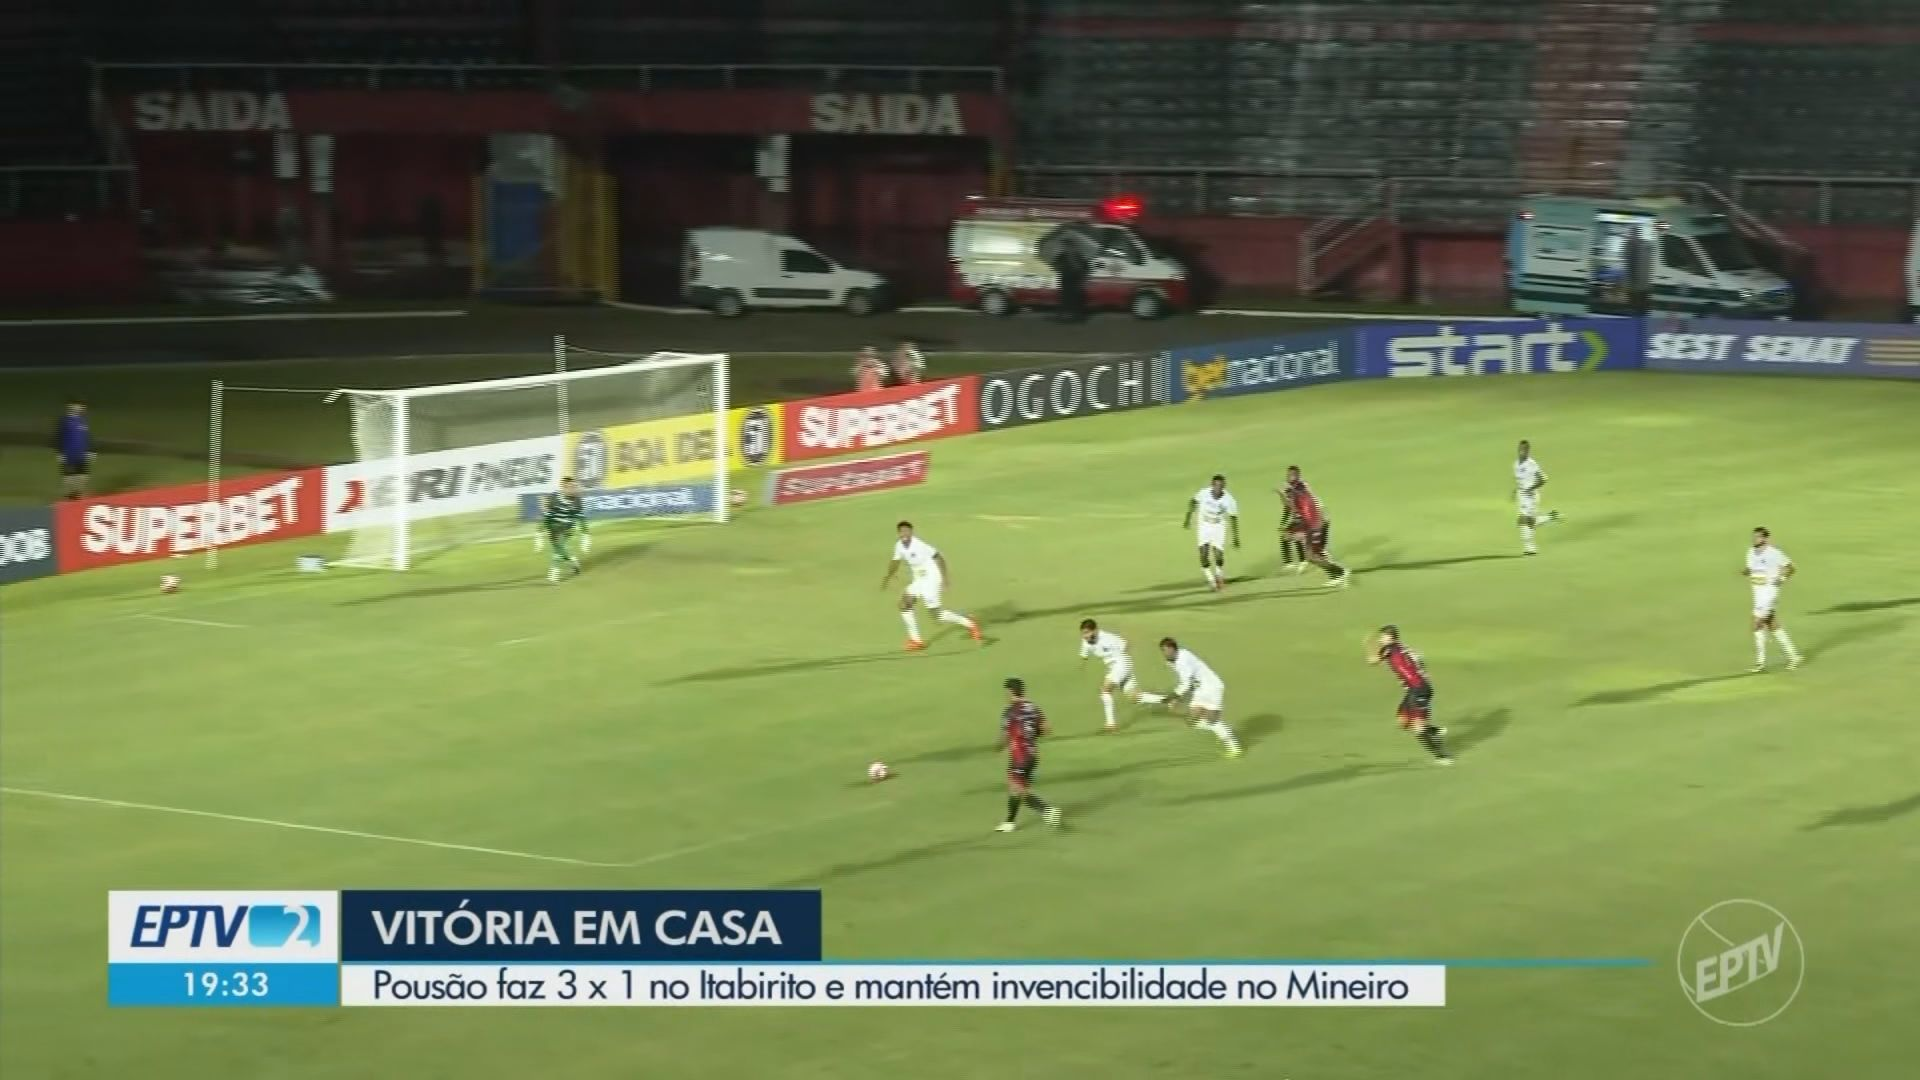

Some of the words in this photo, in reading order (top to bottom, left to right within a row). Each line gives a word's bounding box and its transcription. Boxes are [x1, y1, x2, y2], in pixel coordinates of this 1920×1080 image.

[133, 91, 291, 131] SAIDA
[809, 93, 967, 135] SAIDA
[1180, 339, 1342, 394] betnacional
[1384, 322, 1580, 378] start
[1644, 333, 1741, 361] SEST
[1742, 335, 1862, 364] SENAT
[796, 384, 962, 449] SUPERBET
[613, 437, 669, 474] BOA
[742, 415, 771, 459] 51
[467, 454, 556, 494] PNEUS
[779, 458, 927, 496] SUPERBET
[80, 476, 304, 555] SUPERBET
[582, 487, 696, 513] nacional
